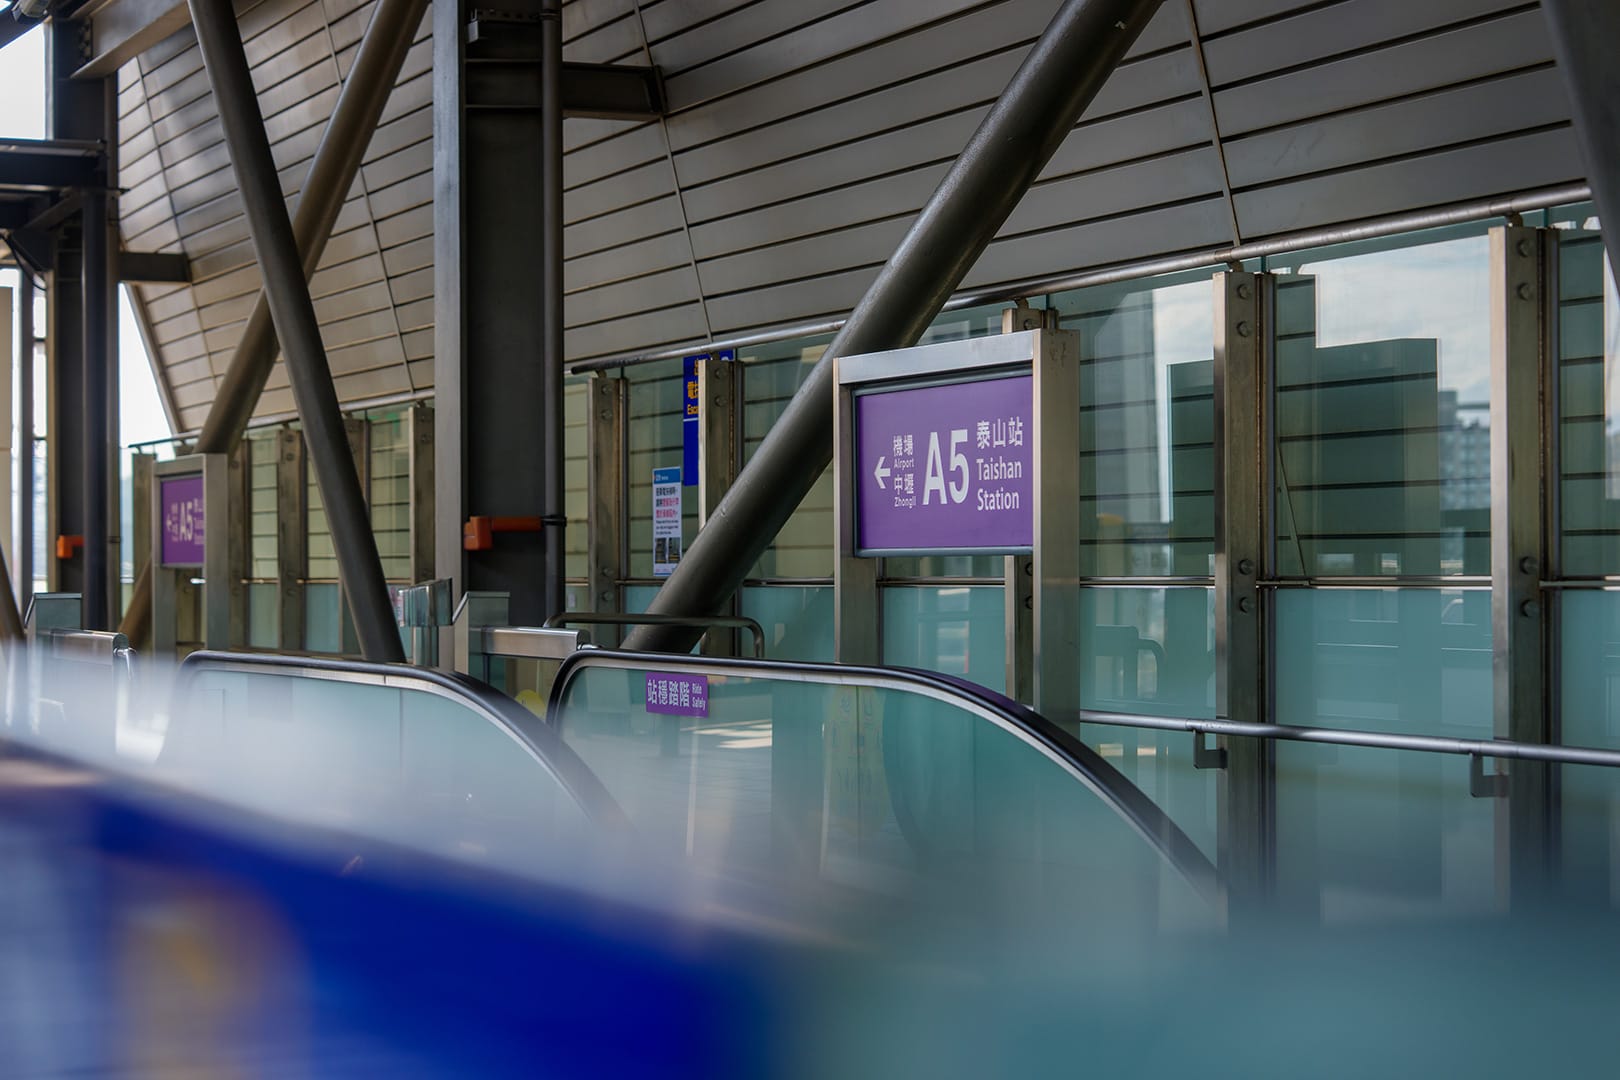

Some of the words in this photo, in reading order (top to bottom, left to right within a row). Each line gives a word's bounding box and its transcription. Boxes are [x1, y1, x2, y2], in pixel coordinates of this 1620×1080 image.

[976, 416, 1024, 450] 泰山站
[893, 434, 914, 457] 機場
[893, 458, 915, 471] Airport
[922, 429, 970, 506] A5
[976, 456, 1022, 481] Taishan
[893, 473, 914, 496] 中壢
[894, 495, 917, 509] Zhongli
[977, 487, 1020, 511] Station
[180, 501, 194, 541] A5
[647, 679, 690, 707] 站穩踏階
